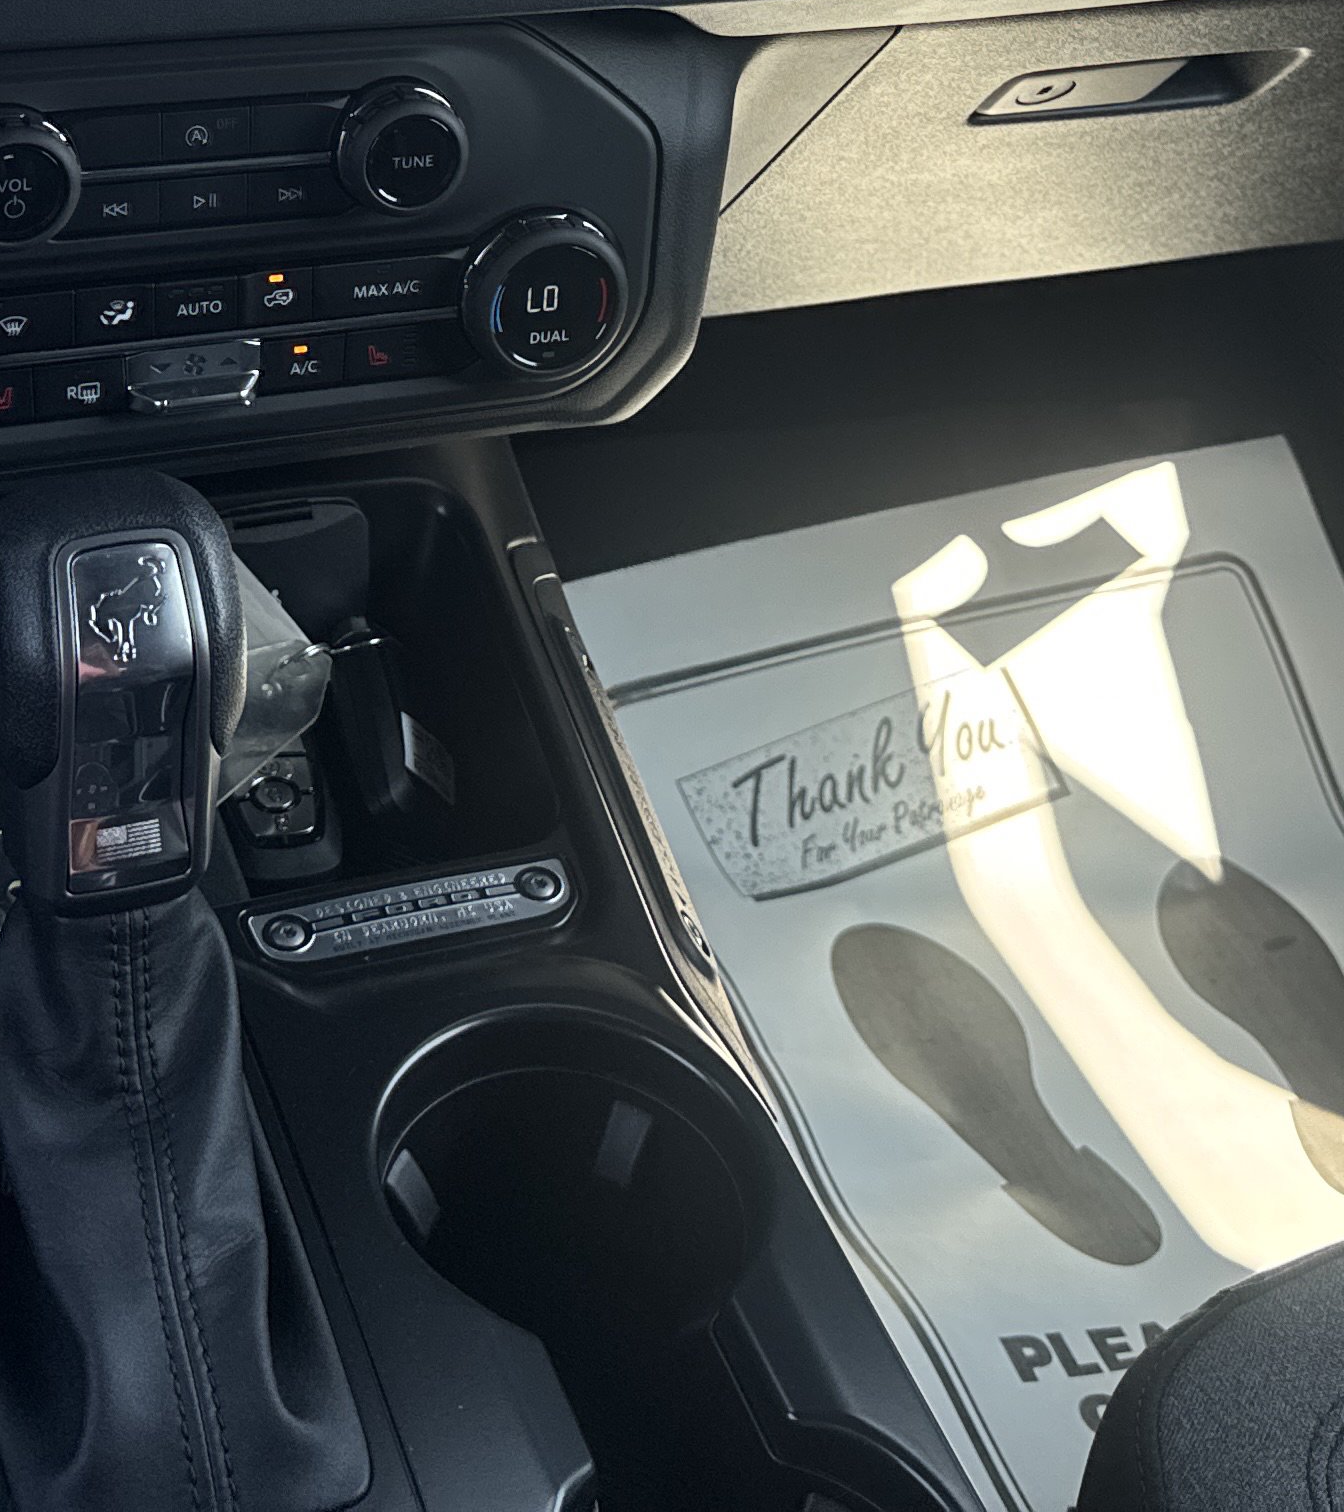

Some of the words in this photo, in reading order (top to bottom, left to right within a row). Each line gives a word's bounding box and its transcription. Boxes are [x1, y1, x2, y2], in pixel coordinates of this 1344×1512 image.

[392, 154, 434, 170] TUNE
[353, 283, 389, 299] MAX
[391, 279, 420, 295] A/C
[526, 285, 559, 313] LO
[176, 300, 223, 317] AUTO
[529, 329, 570, 345] DUAL
[290, 360, 318, 375] A/C
[733, 716, 907, 847] Thank
[916, 690, 1005, 777] You
[802, 834, 837, 871] For
[842, 817, 887, 853] Your
